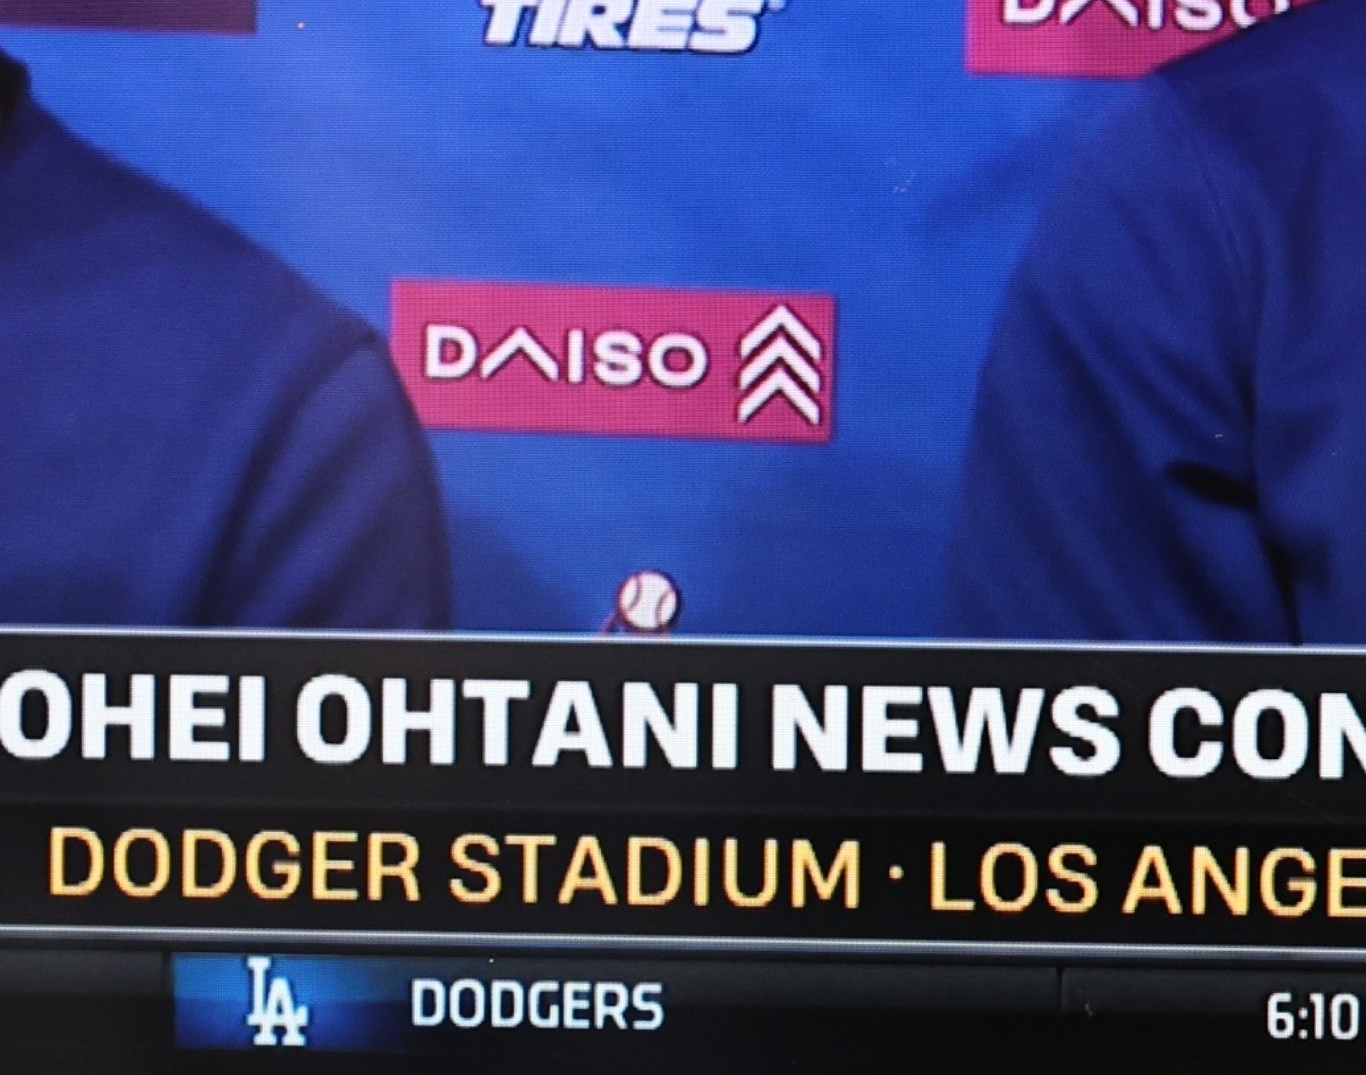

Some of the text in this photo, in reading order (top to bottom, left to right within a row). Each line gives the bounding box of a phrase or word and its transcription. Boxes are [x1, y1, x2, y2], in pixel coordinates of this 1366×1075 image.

[426, 325, 707, 386] DAISO
[296, 674, 737, 769] OHTANI
[772, 684, 1121, 776] NEWS
[50, 827, 420, 901] DODGER
[450, 833, 859, 909] STADIUM
[931, 841, 1098, 913] LOS
[247, 956, 308, 1046] LA
[412, 978, 664, 1030] DODGERS
[1267, 992, 1359, 1040] 6:10
